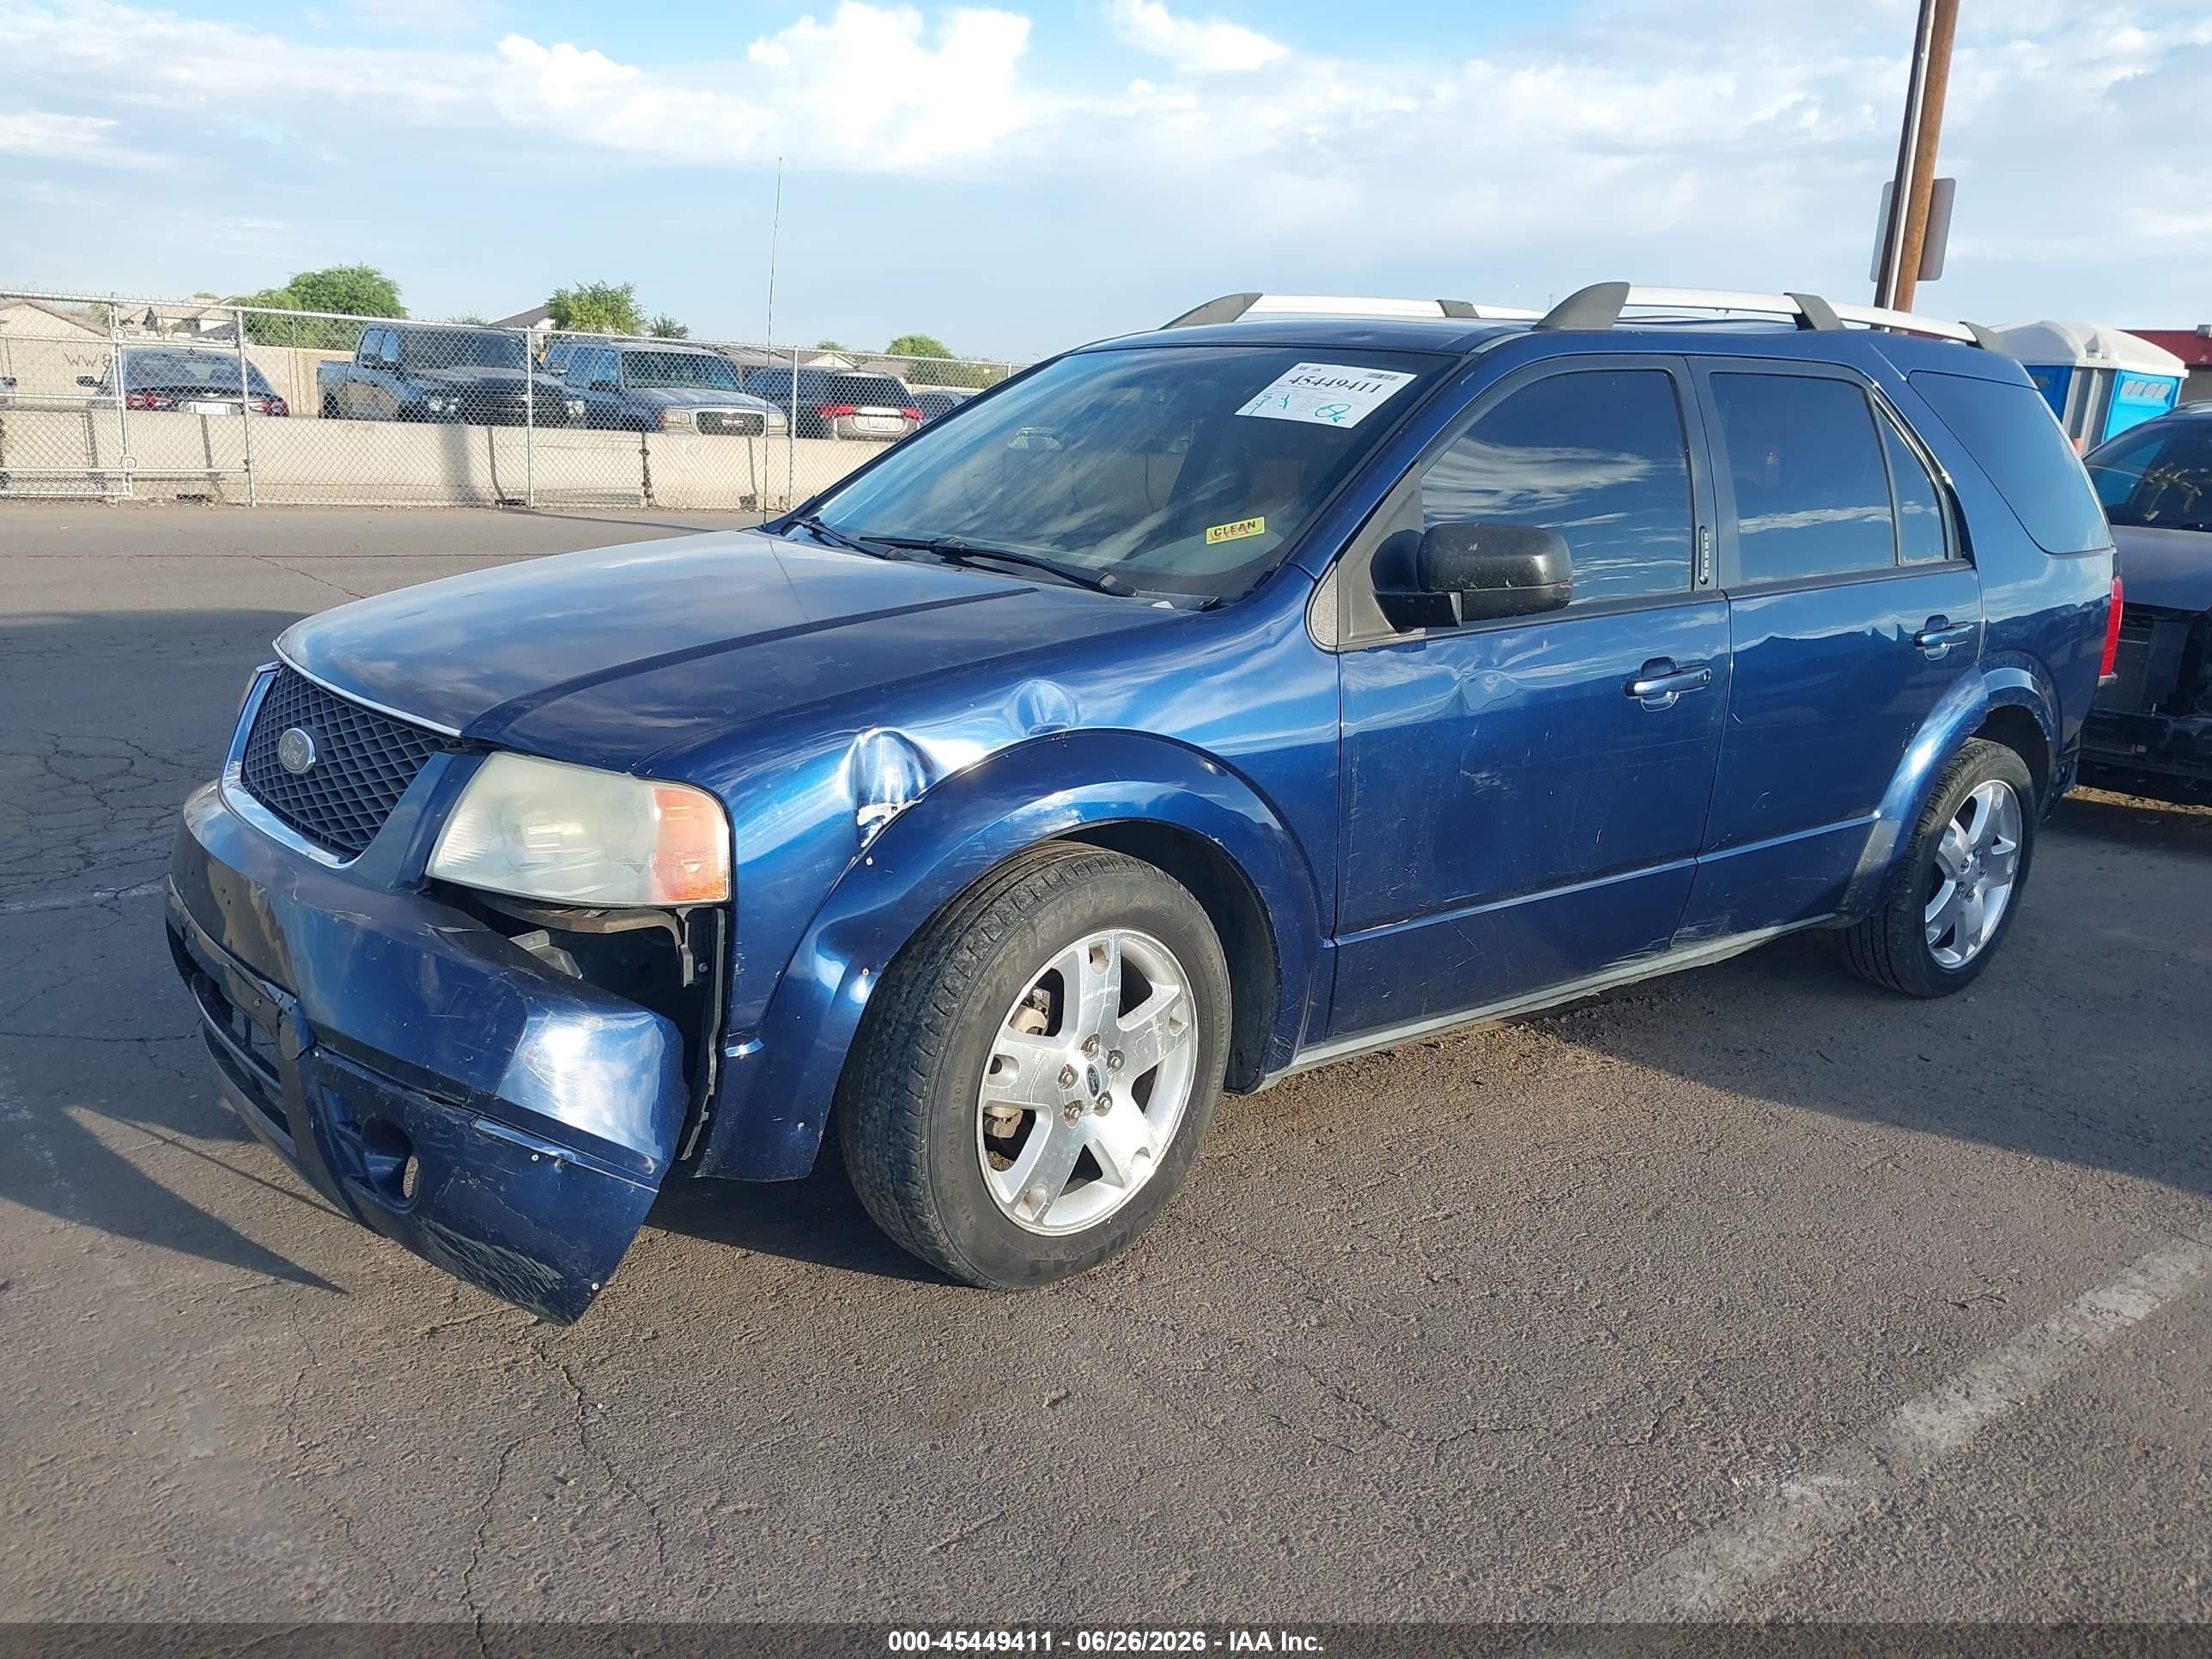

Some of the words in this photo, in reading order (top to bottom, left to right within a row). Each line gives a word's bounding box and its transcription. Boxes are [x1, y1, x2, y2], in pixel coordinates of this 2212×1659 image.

[1288, 374, 1383, 393] 45449411
[1213, 520, 1256, 537] CLEAN
[283, 735, 305, 765] Ford
